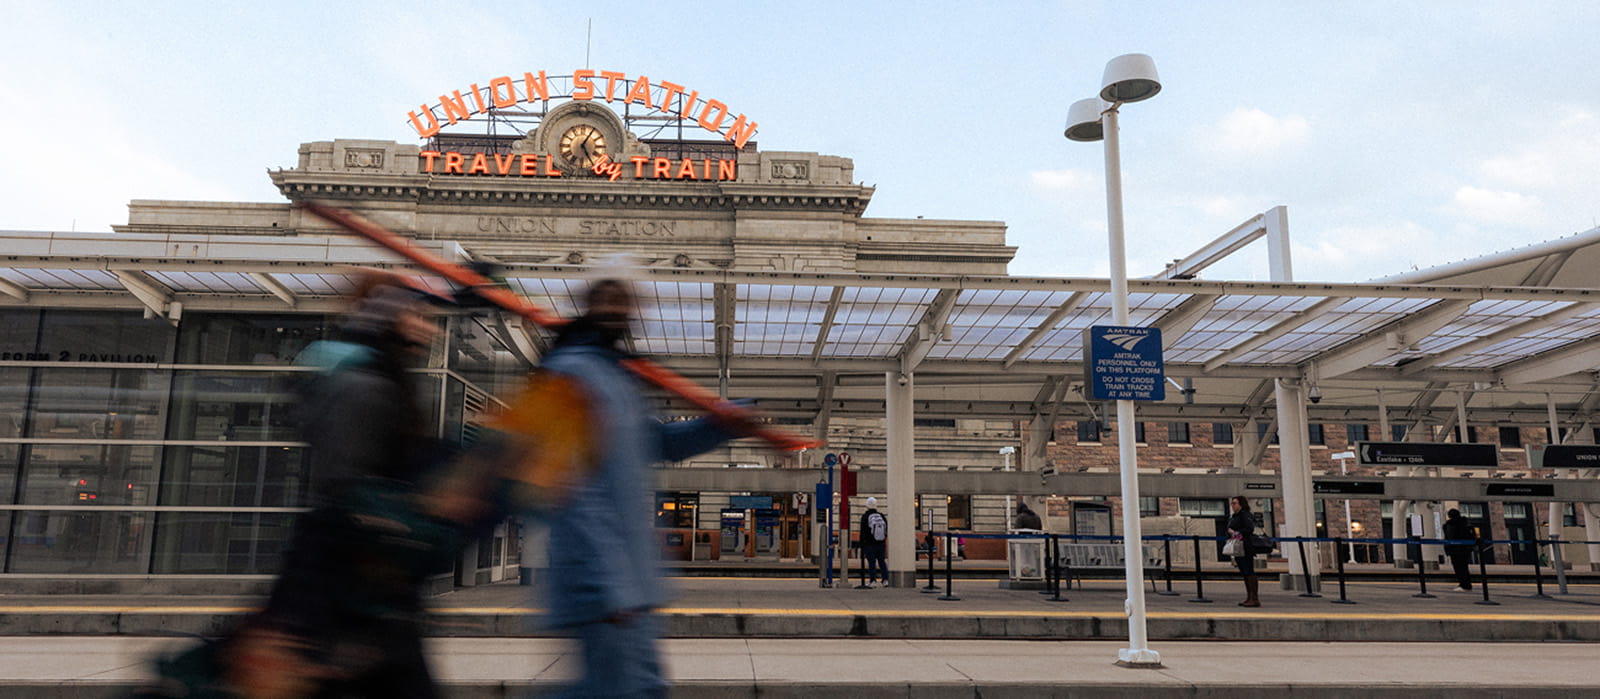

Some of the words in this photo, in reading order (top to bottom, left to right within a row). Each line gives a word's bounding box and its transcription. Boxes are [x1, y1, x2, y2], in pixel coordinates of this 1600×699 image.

[408, 70, 550, 138] UNION
[572, 69, 758, 149] STATION
[420, 151, 562, 177] TRAVEL
[592, 154, 622, 181] by
[630, 156, 737, 180] TRAIN
[478, 216, 557, 234] UNION
[579, 219, 677, 237] STATION
[59, 350, 71, 362] 2
[79, 353, 156, 363] PAVILION
[1098, 359, 1137, 367] PERSONNEL
[840, 455, 849, 464] V
